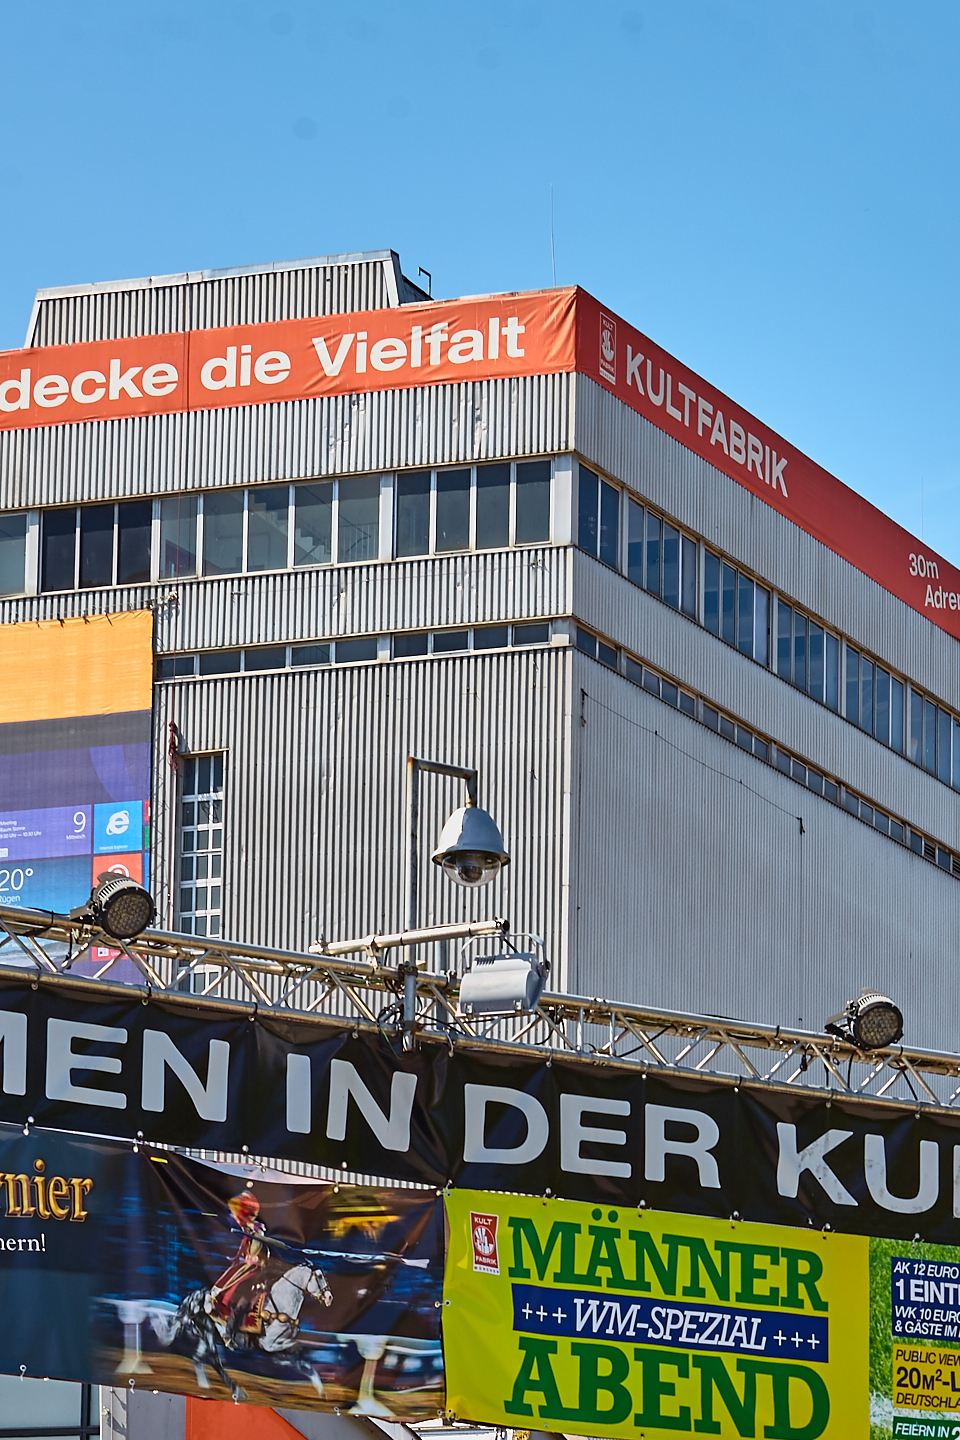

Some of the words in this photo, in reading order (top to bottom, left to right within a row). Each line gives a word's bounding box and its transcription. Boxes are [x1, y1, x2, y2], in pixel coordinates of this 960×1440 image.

[0, 358, 178, 412] decke
[201, 344, 291, 391] die
[313, 316, 526, 378] Vielfalt
[626, 344, 789, 498] KULTFABRIK
[908, 552, 939, 580] 30m
[73, 811, 86, 833] 9
[285, 1052, 418, 1153] IN
[463, 1083, 721, 1190] DER
[473, 1216, 493, 1226] KULT
[475, 1255, 497, 1266] FABRIK
[507, 1208, 829, 1311] MÄNNER
[893, 1261, 910, 1275] AK
[913, 1263, 926, 1276] 12
[927, 1265, 960, 1280] EURO
[895, 1278, 905, 1301] 1
[894, 1305, 917, 1319] VVK
[919, 1308, 932, 1320] 10
[573, 1298, 767, 1350] WM-SPEZIAL
[894, 1320, 903, 1333] &
[905, 1318, 942, 1337] GÄSTE
[944, 1325, 958, 1338] IM
[895, 1349, 937, 1364] PUBLIC
[895, 1422, 936, 1438] FEIERN
[937, 1426, 950, 1439] IN
